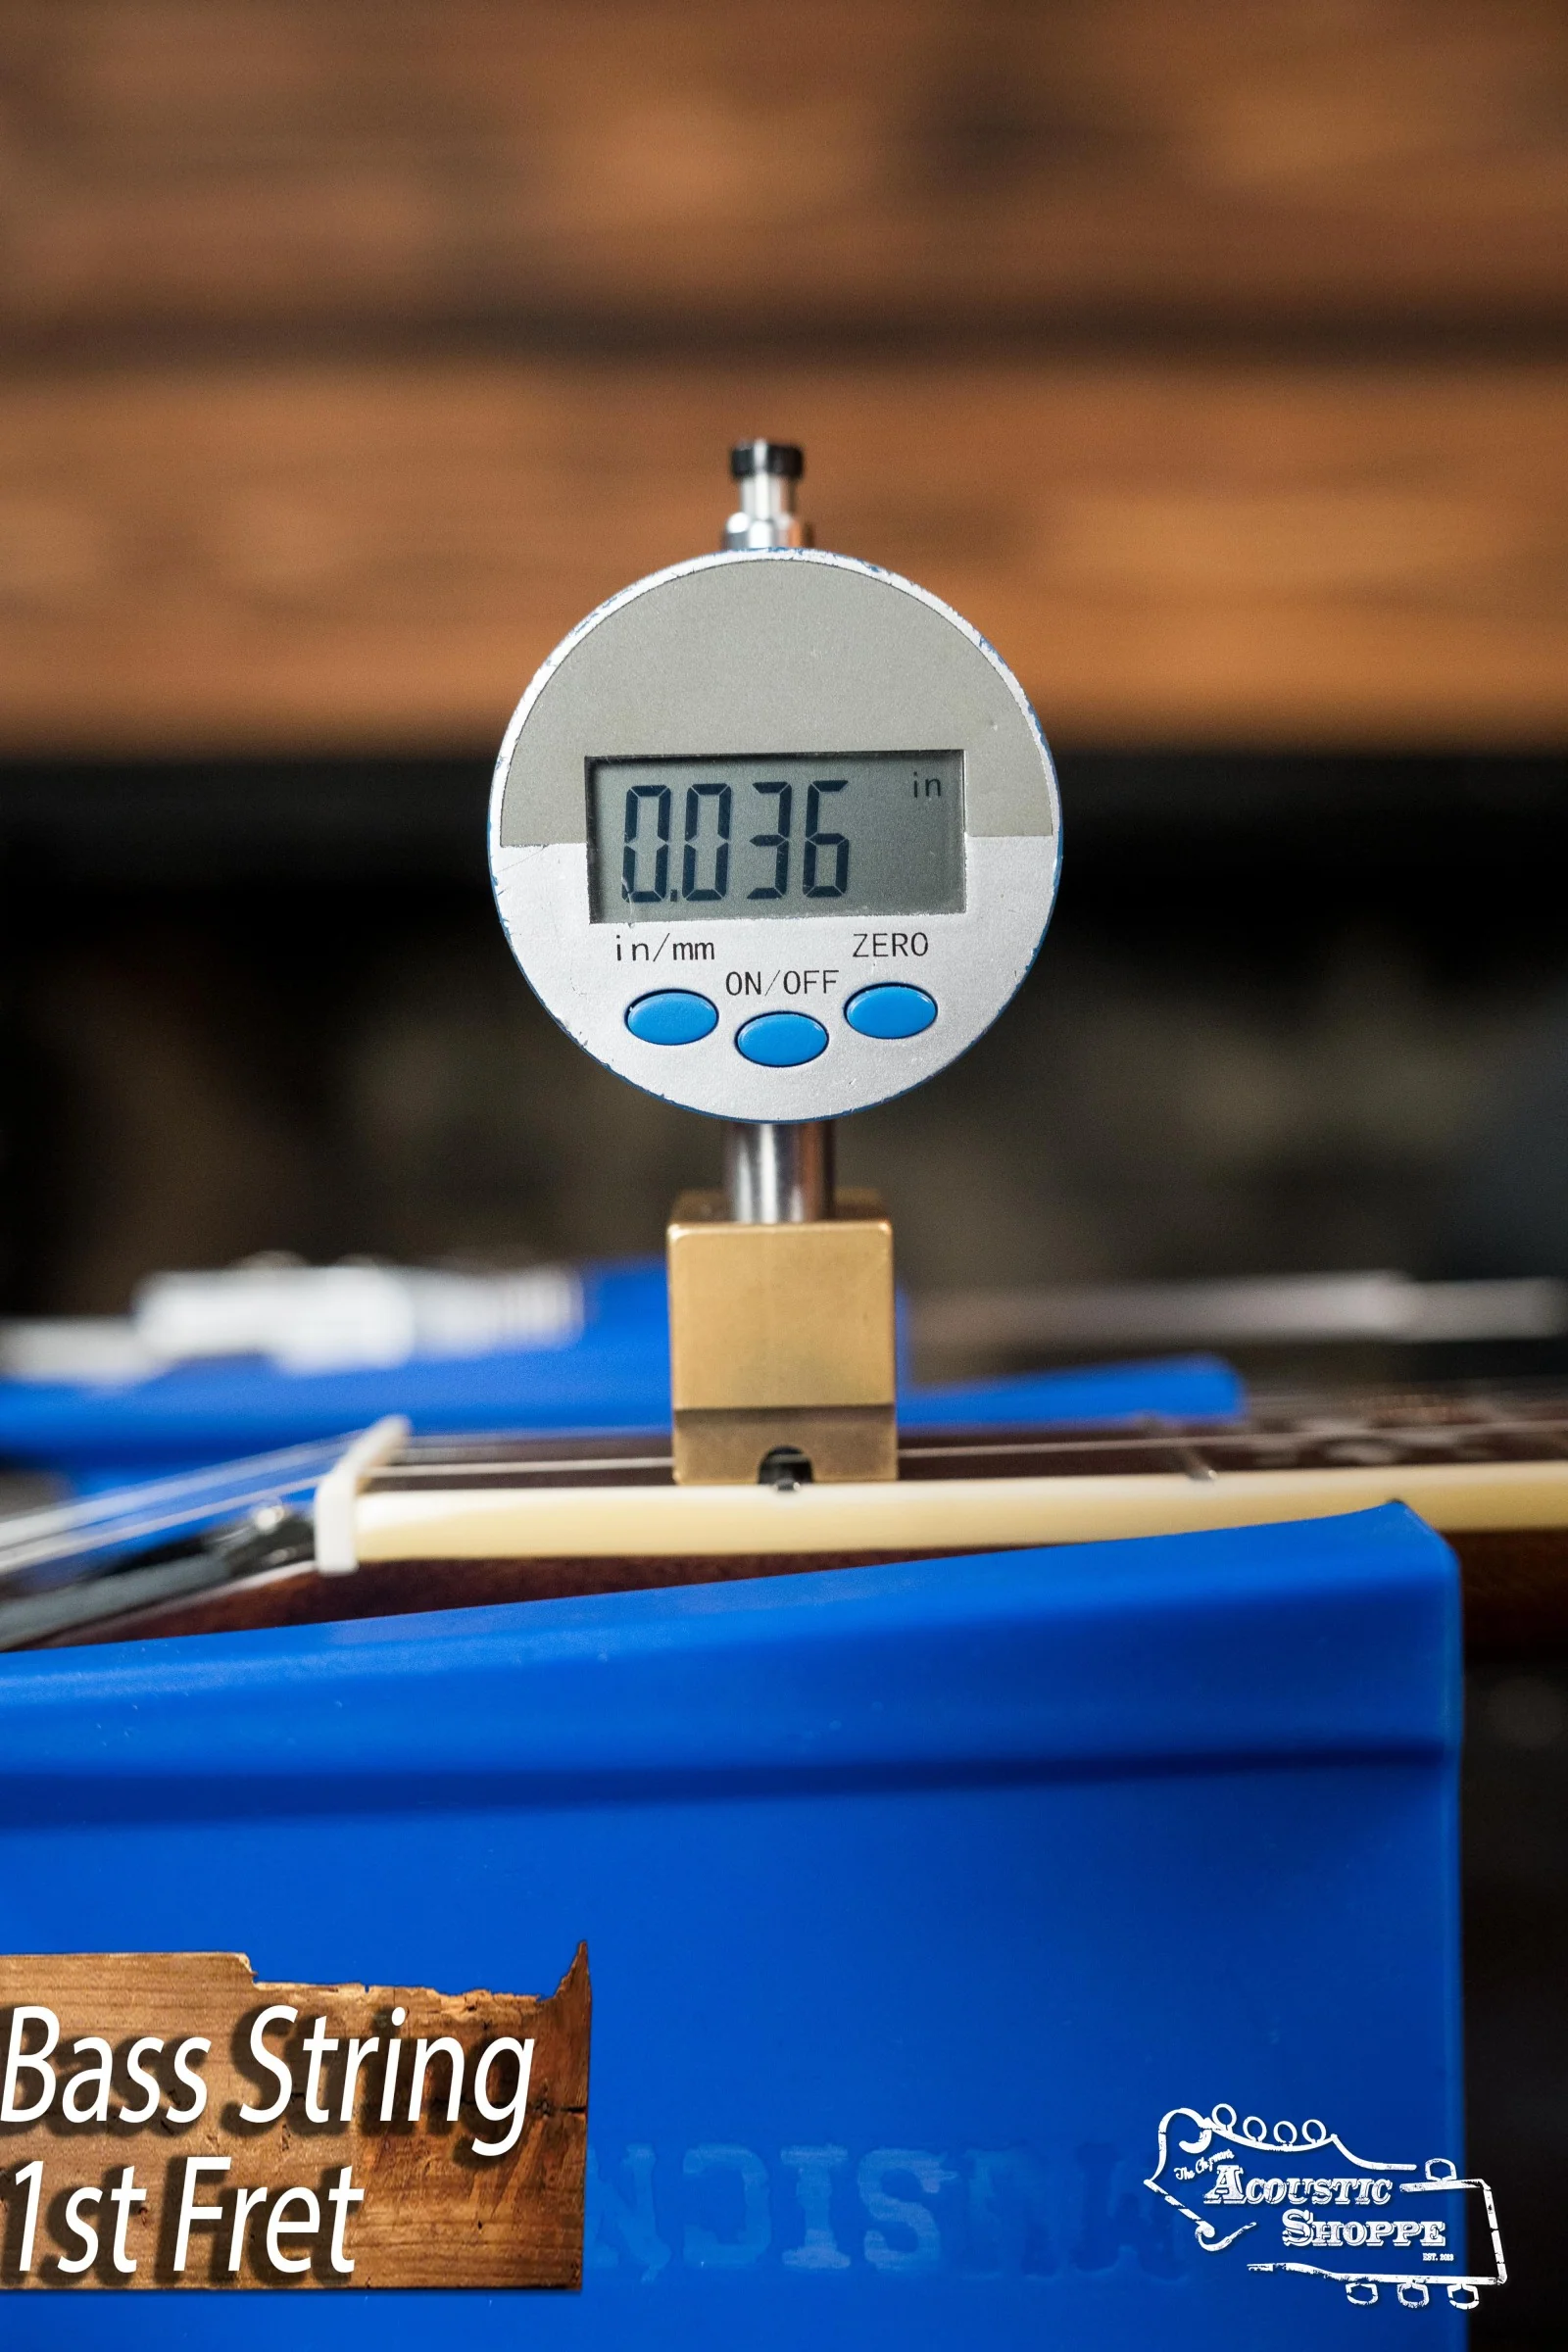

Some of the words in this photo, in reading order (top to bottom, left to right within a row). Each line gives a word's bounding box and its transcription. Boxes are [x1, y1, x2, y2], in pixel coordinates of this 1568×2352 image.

[912, 771, 943, 799] in
[621, 779, 850, 903] 0.036
[614, 932, 715, 962] in/mm
[852, 931, 930, 958] ZERO
[724, 969, 840, 998] ON/OFF
